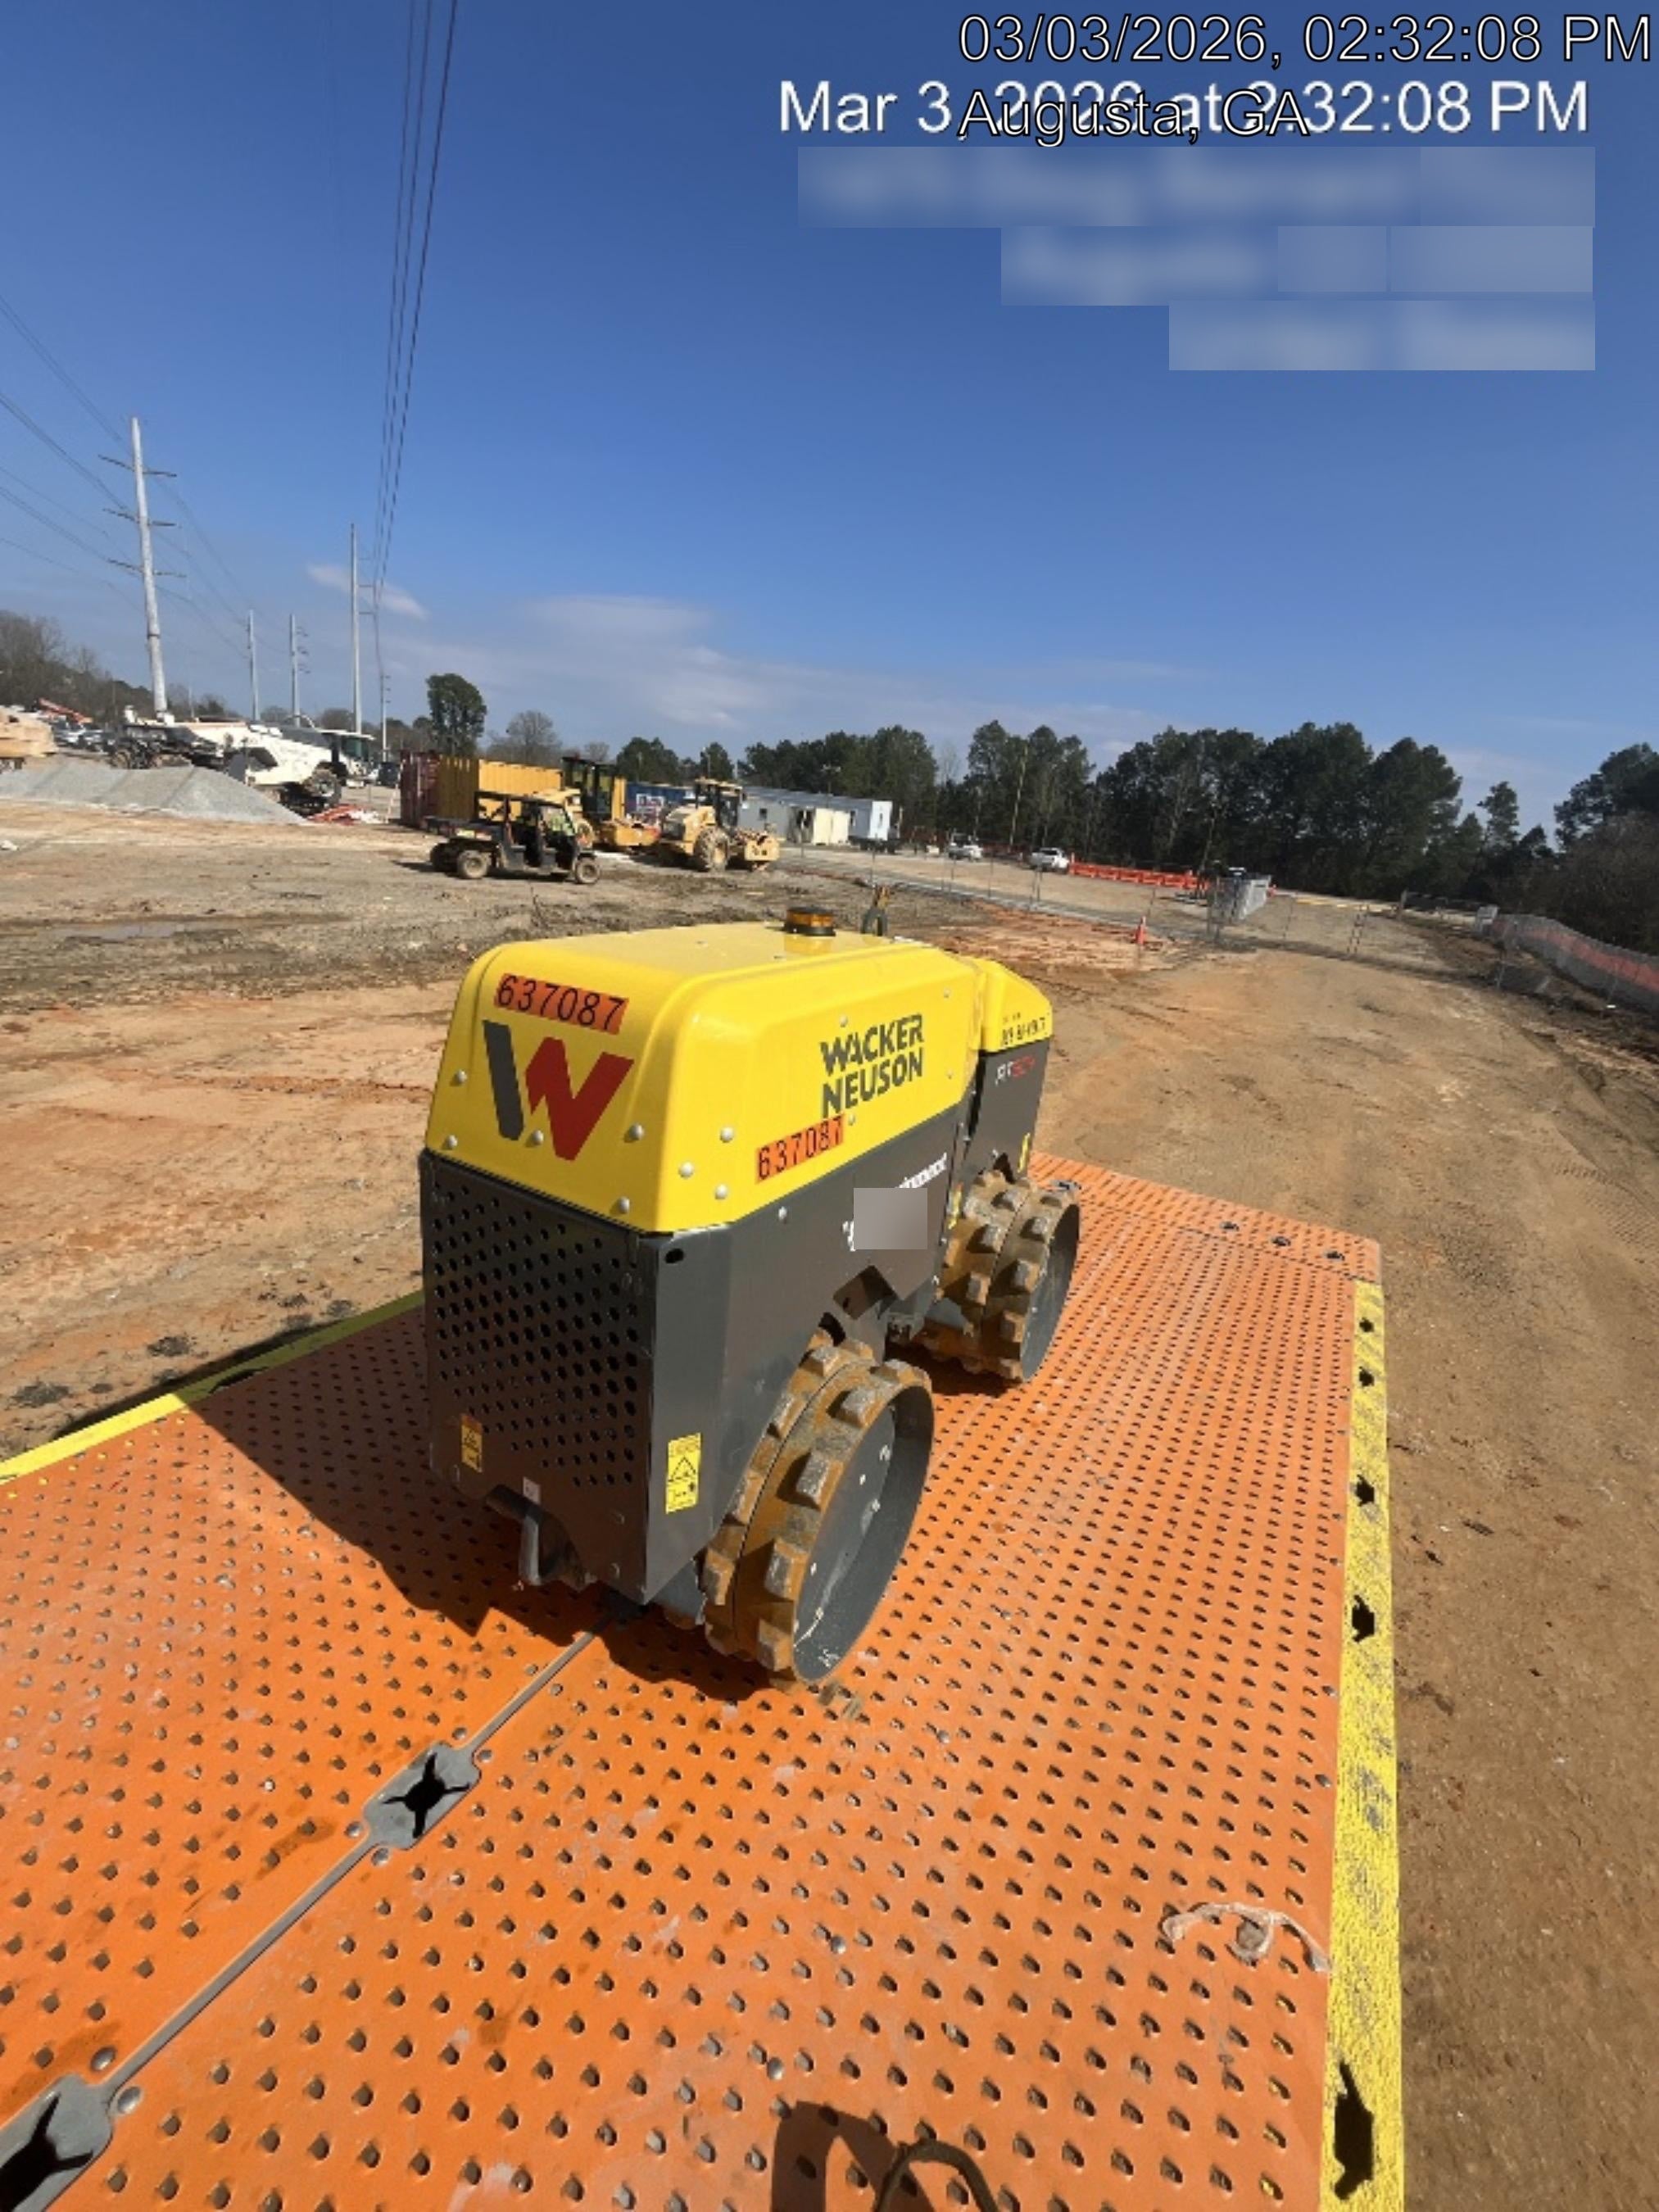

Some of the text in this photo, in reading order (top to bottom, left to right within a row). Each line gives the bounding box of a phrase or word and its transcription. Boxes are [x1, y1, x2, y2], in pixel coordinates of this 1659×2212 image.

[496, 975, 626, 1032] 637087
[819, 1012, 925, 1077] WACKER
[822, 1046, 923, 1119] NEUSON
[759, 1114, 842, 1180] 637087
